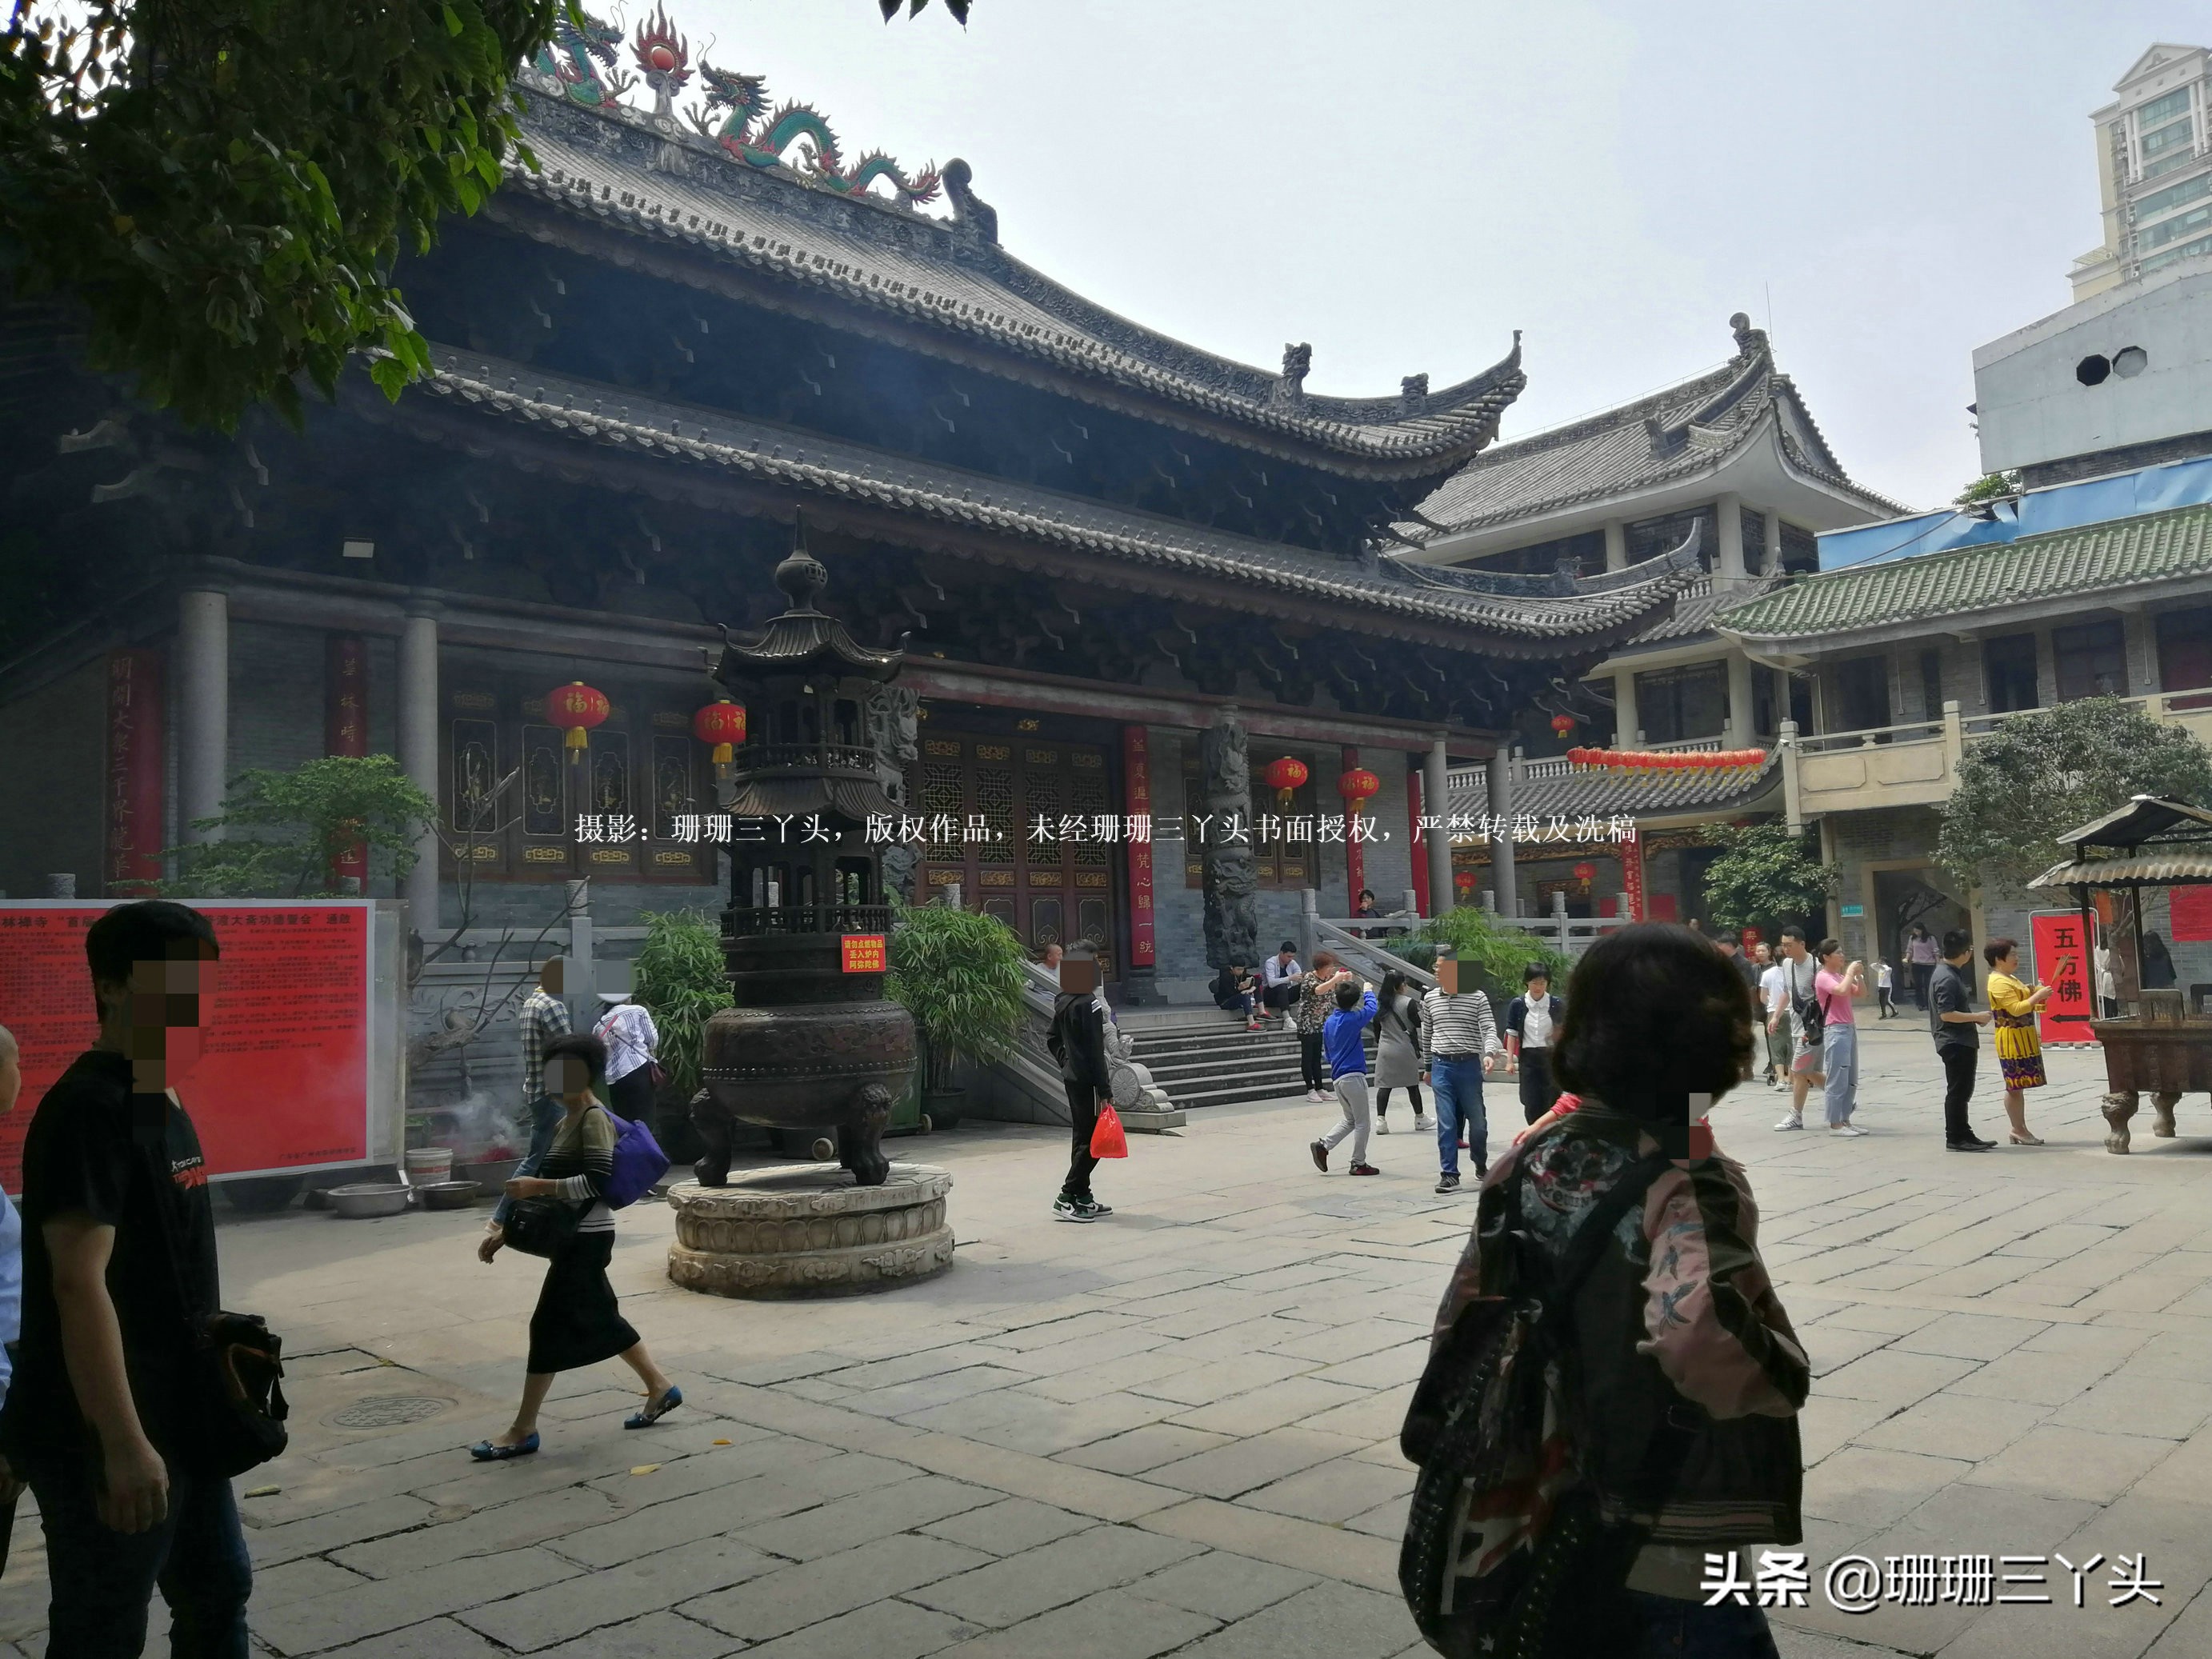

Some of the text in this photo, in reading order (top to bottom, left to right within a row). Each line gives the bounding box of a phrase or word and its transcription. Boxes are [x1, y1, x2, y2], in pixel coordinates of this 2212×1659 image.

[564, 691, 586, 714] 福
[844, 939, 883, 949] 请勿点燃物品
[850, 949, 879, 959] 丢入炉内
[849, 960, 879, 969] 阿弥陀佛
